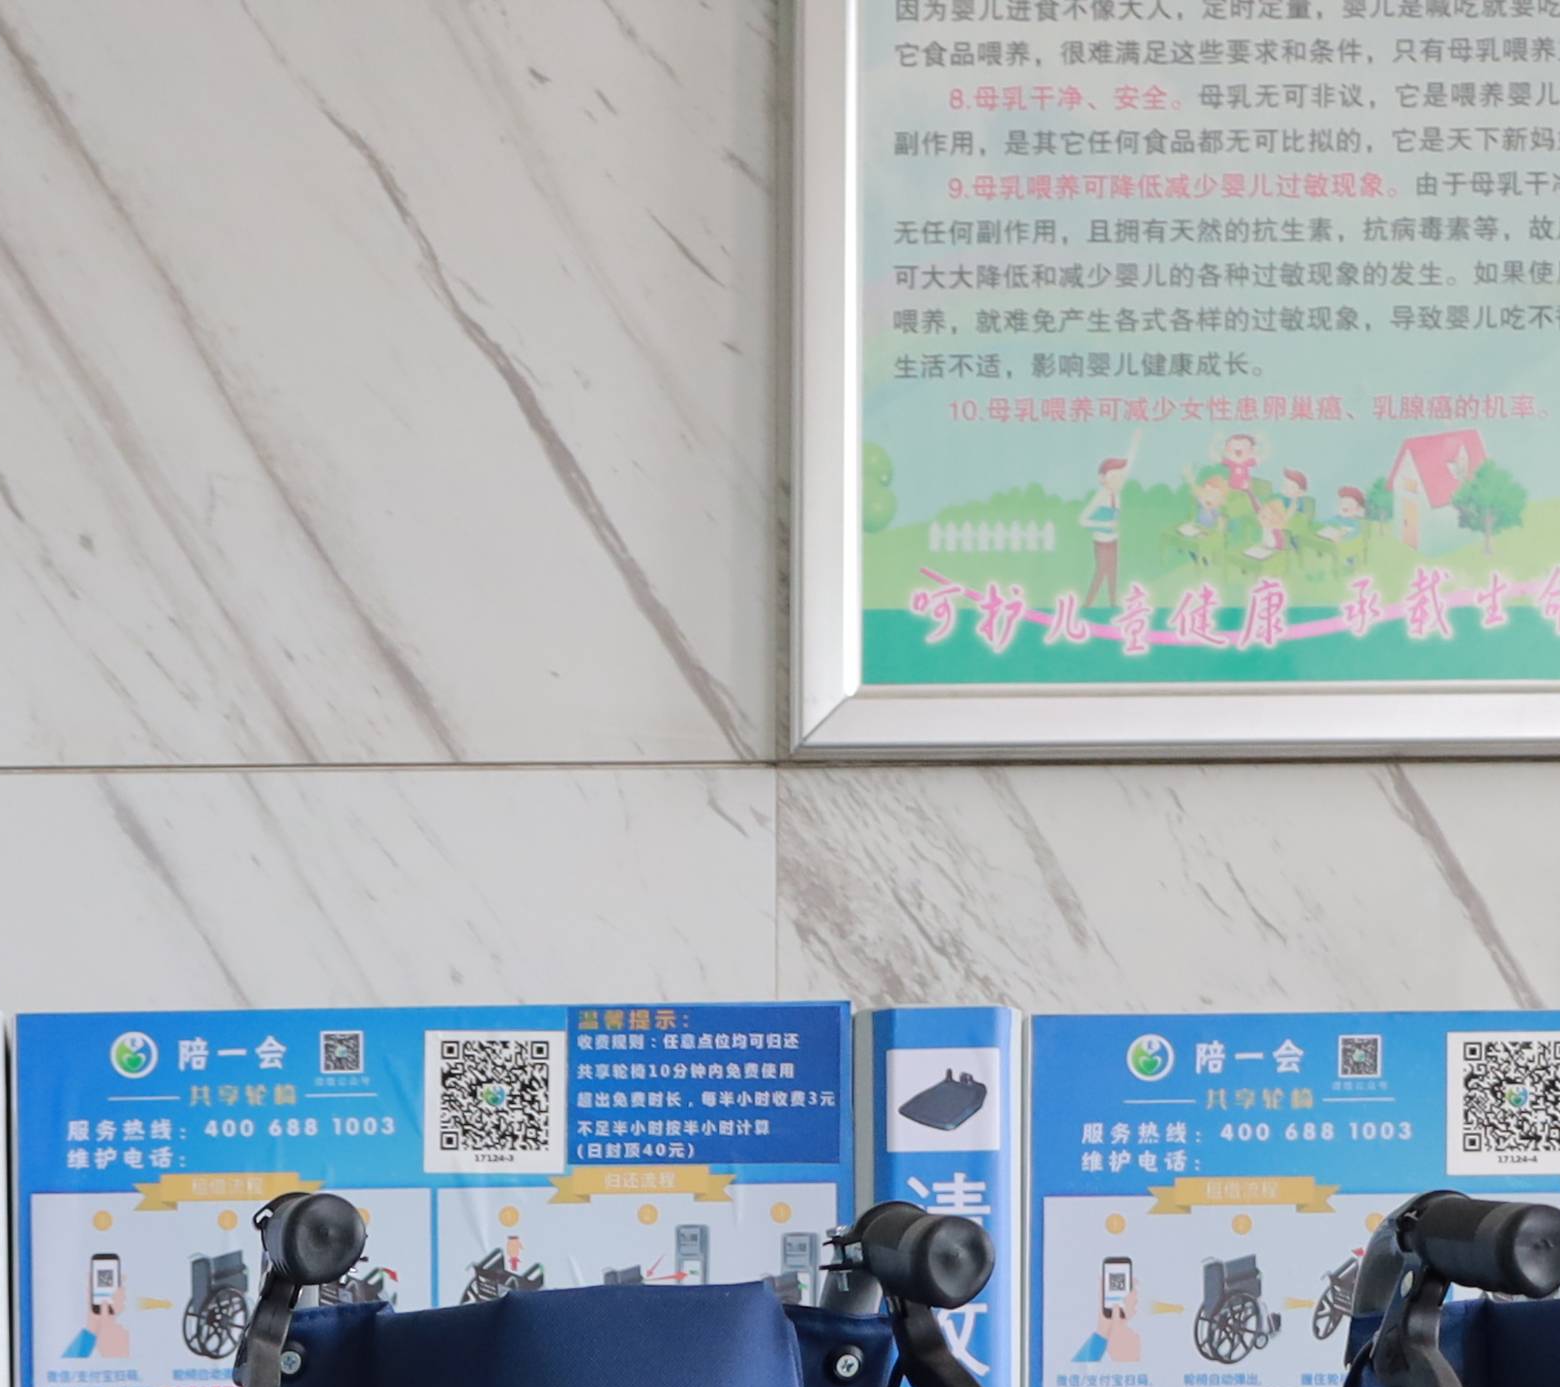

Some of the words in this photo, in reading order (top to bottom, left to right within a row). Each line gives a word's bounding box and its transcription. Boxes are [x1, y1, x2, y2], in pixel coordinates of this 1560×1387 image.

[893, 351, 1264, 380] 生活不适，影响婴儿健康成长。
[176, 1034, 288, 1072] 陪一会
[1194, 1038, 1306, 1076] 陪一会
[66, 1118, 188, 1142] 服务热线：
[203, 1116, 256, 1138] 400
[267, 1116, 319, 1138] 688
[331, 1116, 397, 1137] 1003
[576, 1118, 771, 1136] 不足半小时按半小时计算
[1081, 1121, 1203, 1145] 服务热线：
[1219, 1121, 1271, 1142] 400
[1284, 1121, 1335, 1142] 688
[1348, 1121, 1414, 1142] 1003
[66, 1147, 188, 1170] 维护电话：
[473, 1152, 515, 1163] 17124-3
[1081, 1150, 1202, 1173] 维护电话：
[1497, 1155, 1539, 1164] 17124-4
